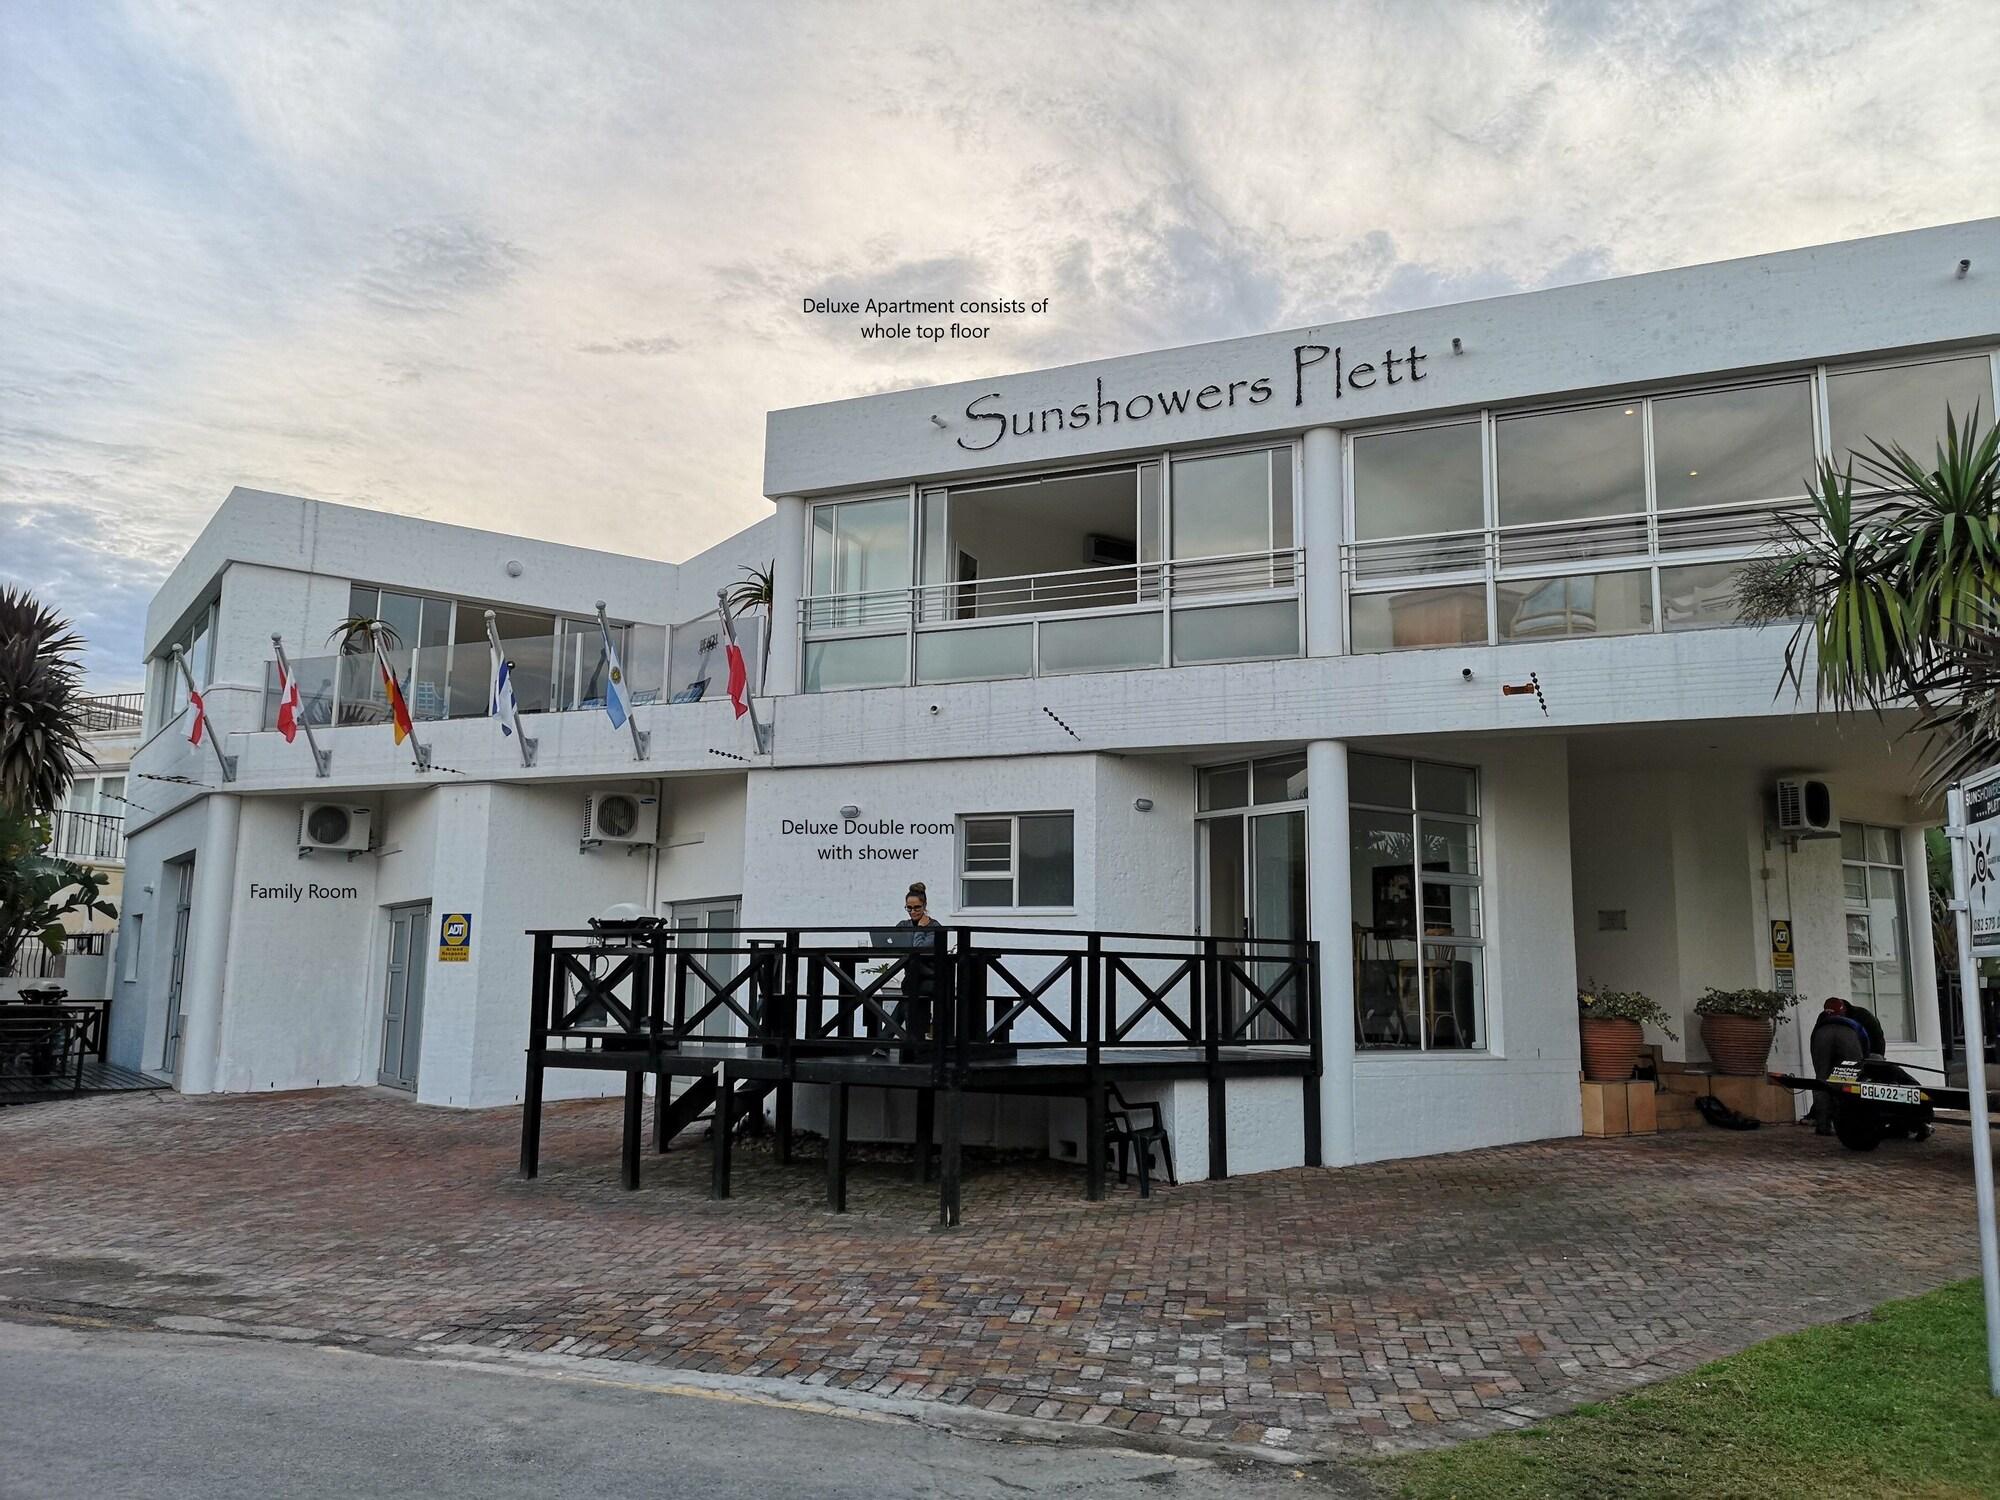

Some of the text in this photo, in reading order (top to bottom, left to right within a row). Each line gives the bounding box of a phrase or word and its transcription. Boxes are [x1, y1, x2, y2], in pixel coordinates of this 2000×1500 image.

[957, 345, 1428, 451] Sunshowers Plett
[447, 924, 464, 935] ADT
